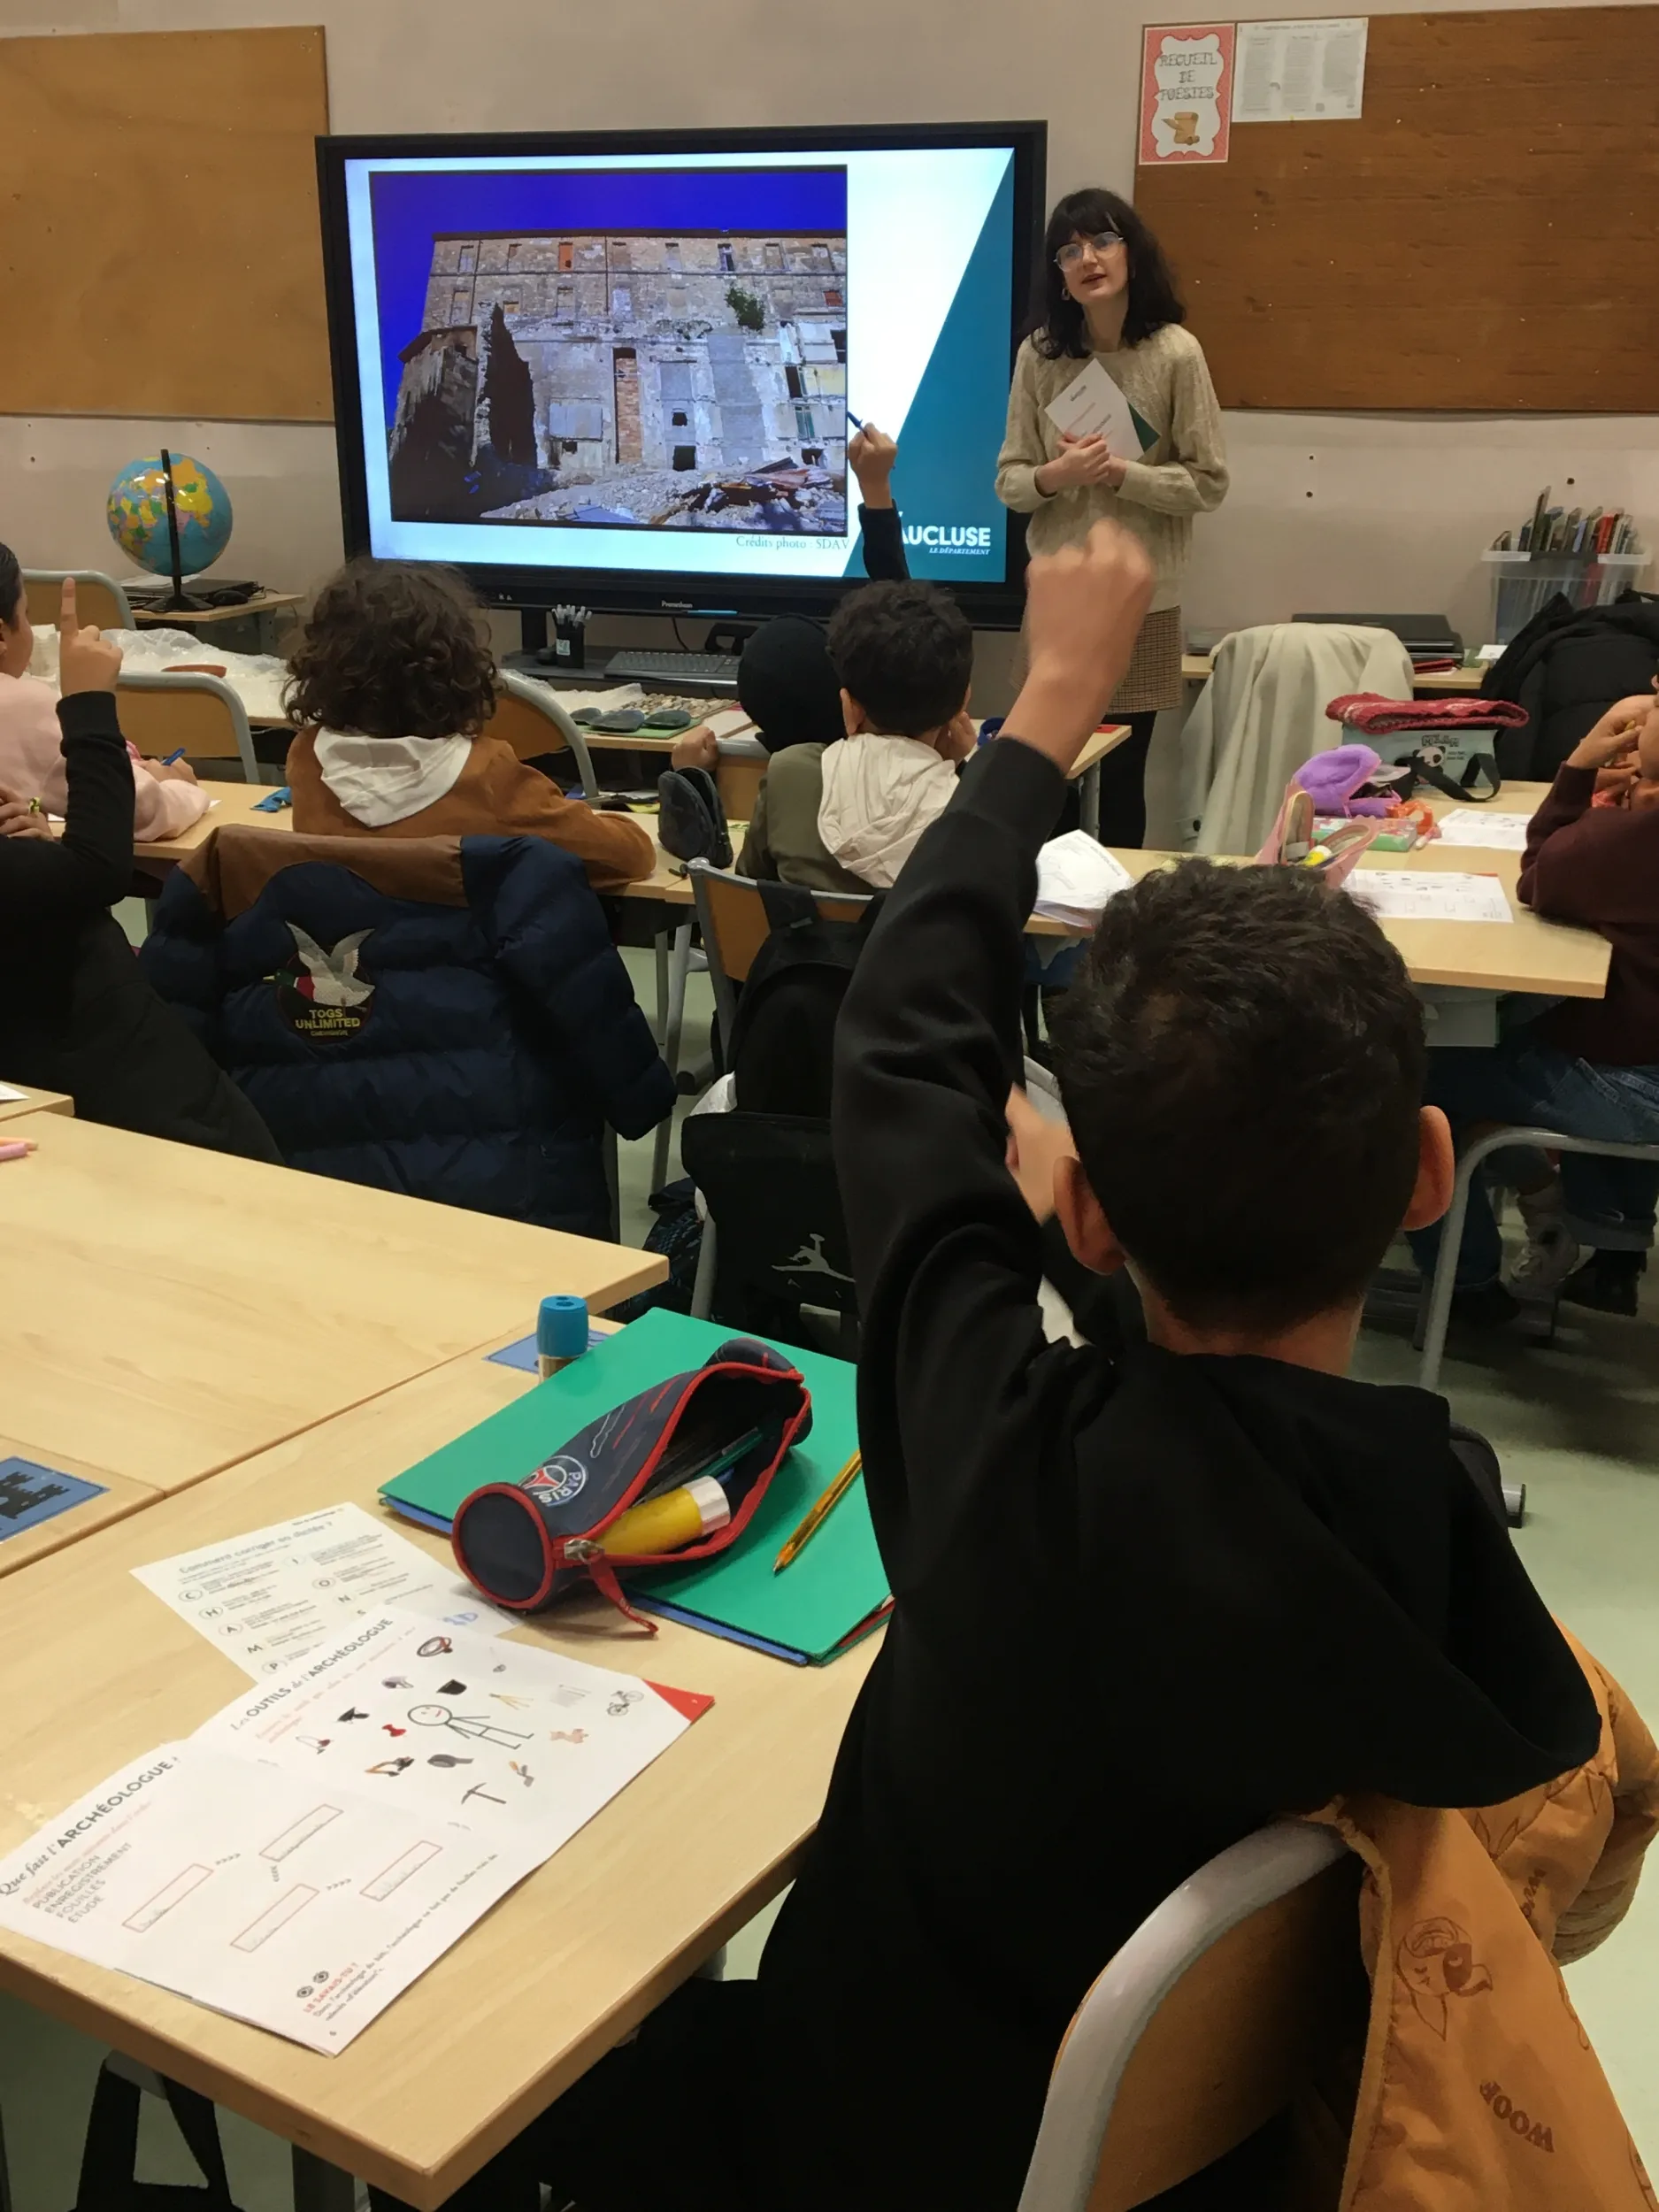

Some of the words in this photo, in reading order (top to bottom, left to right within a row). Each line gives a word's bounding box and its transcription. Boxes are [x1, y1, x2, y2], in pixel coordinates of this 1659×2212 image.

[1159, 52, 1217, 67] RECUEIL
[1179, 69, 1195, 83] DE
[736, 534, 773, 548] Crédits
[776, 535, 807, 551] photo
[939, 547, 991, 556] DÉPARTEMENT
[295, 1017, 361, 1029] UNLIMITED
[308, 1009, 343, 1019] TOGS
[538, 1471, 582, 1503] PARIS
[245, 1686, 292, 1717] OUTILS
[0, 1871, 27, 1896] Que
[25, 1854, 50, 1877] fait
[32, 1855, 102, 1909] PUBLICATION
[44, 1842, 132, 1914] ENREGISTREMENT
[56, 1879, 106, 1918] FOUILLES
[1479, 2081, 1555, 2154] WOOF
